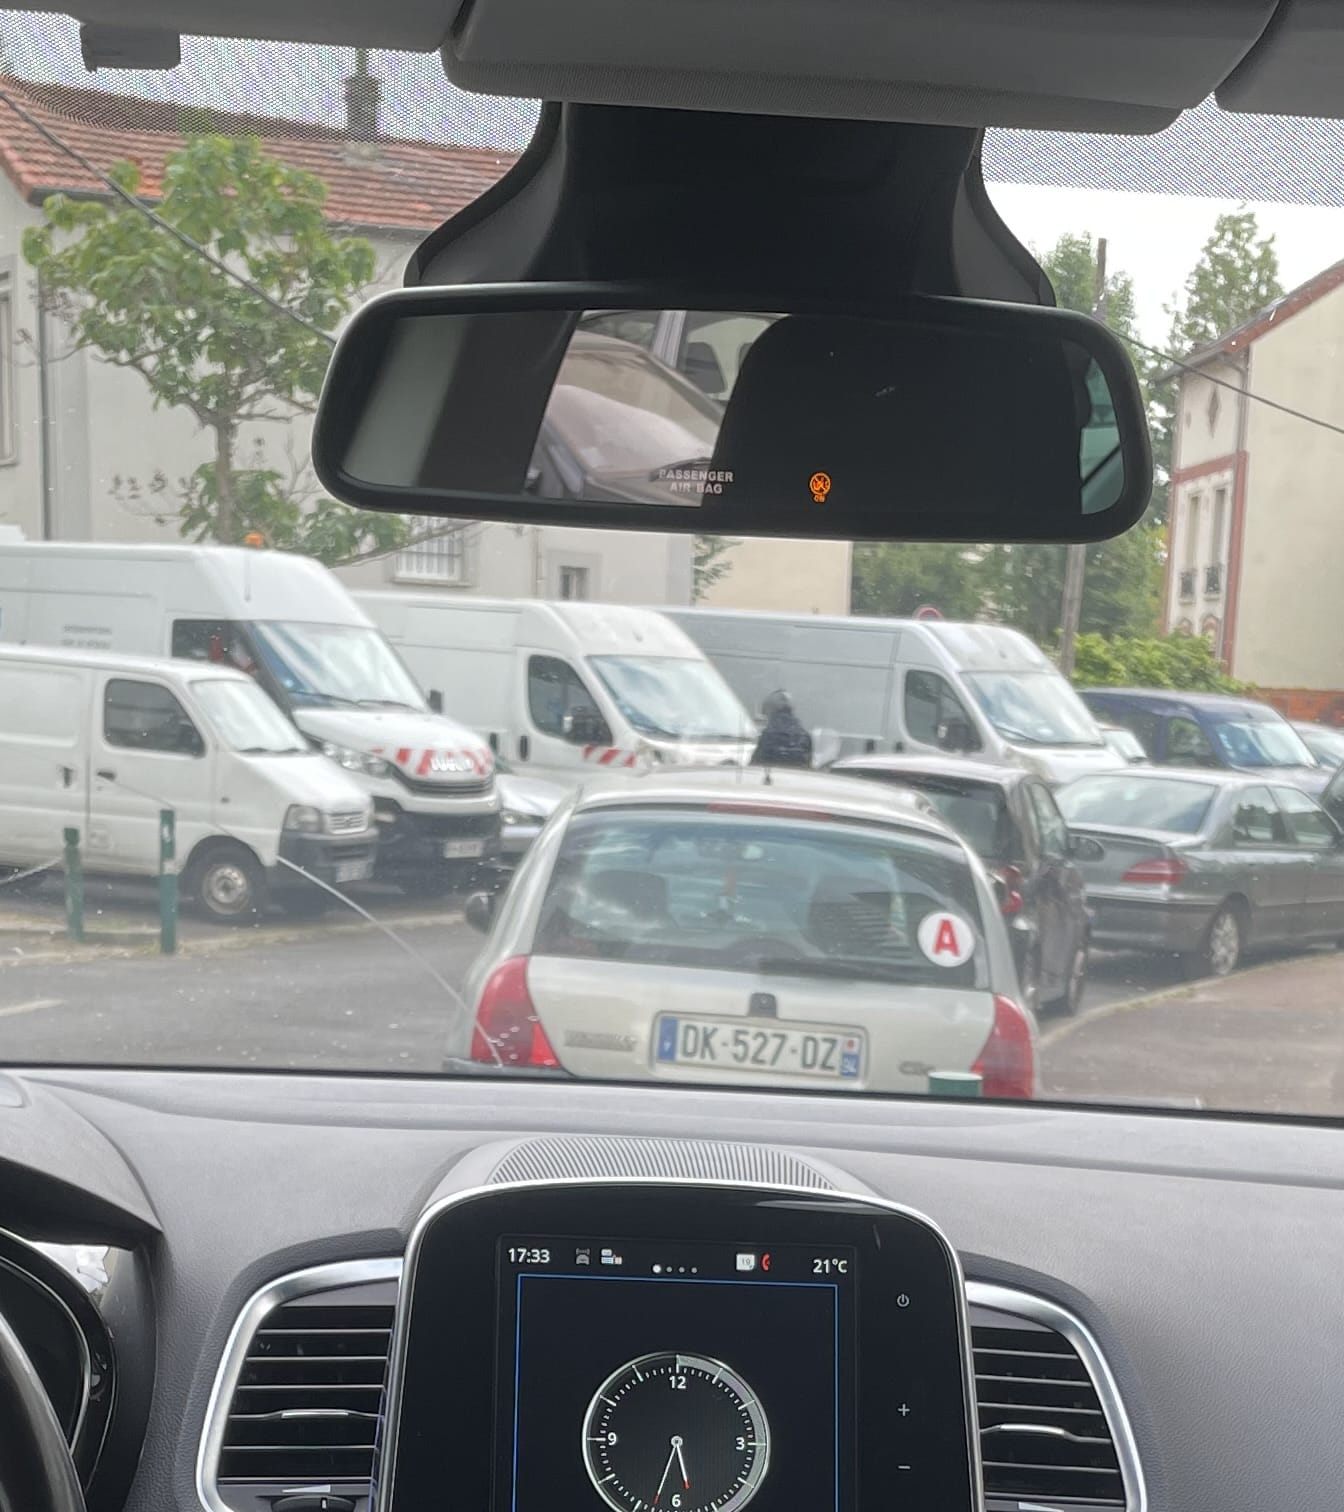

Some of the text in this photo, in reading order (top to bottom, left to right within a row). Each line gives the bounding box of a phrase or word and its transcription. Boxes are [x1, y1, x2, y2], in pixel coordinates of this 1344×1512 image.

[658, 468, 734, 482] PASSENGER
[670, 482, 723, 495] AIR BAG
[932, 918, 960, 957] A
[680, 1025, 837, 1072] DK-527-DZ
[507, 1247, 551, 1265] 17:33
[812, 1258, 848, 1275] 21°C
[668, 1375, 687, 1390] 12
[607, 1431, 618, 1447] 9
[735, 1436, 746, 1451] 3
[671, 1494, 682, 1508] 6
